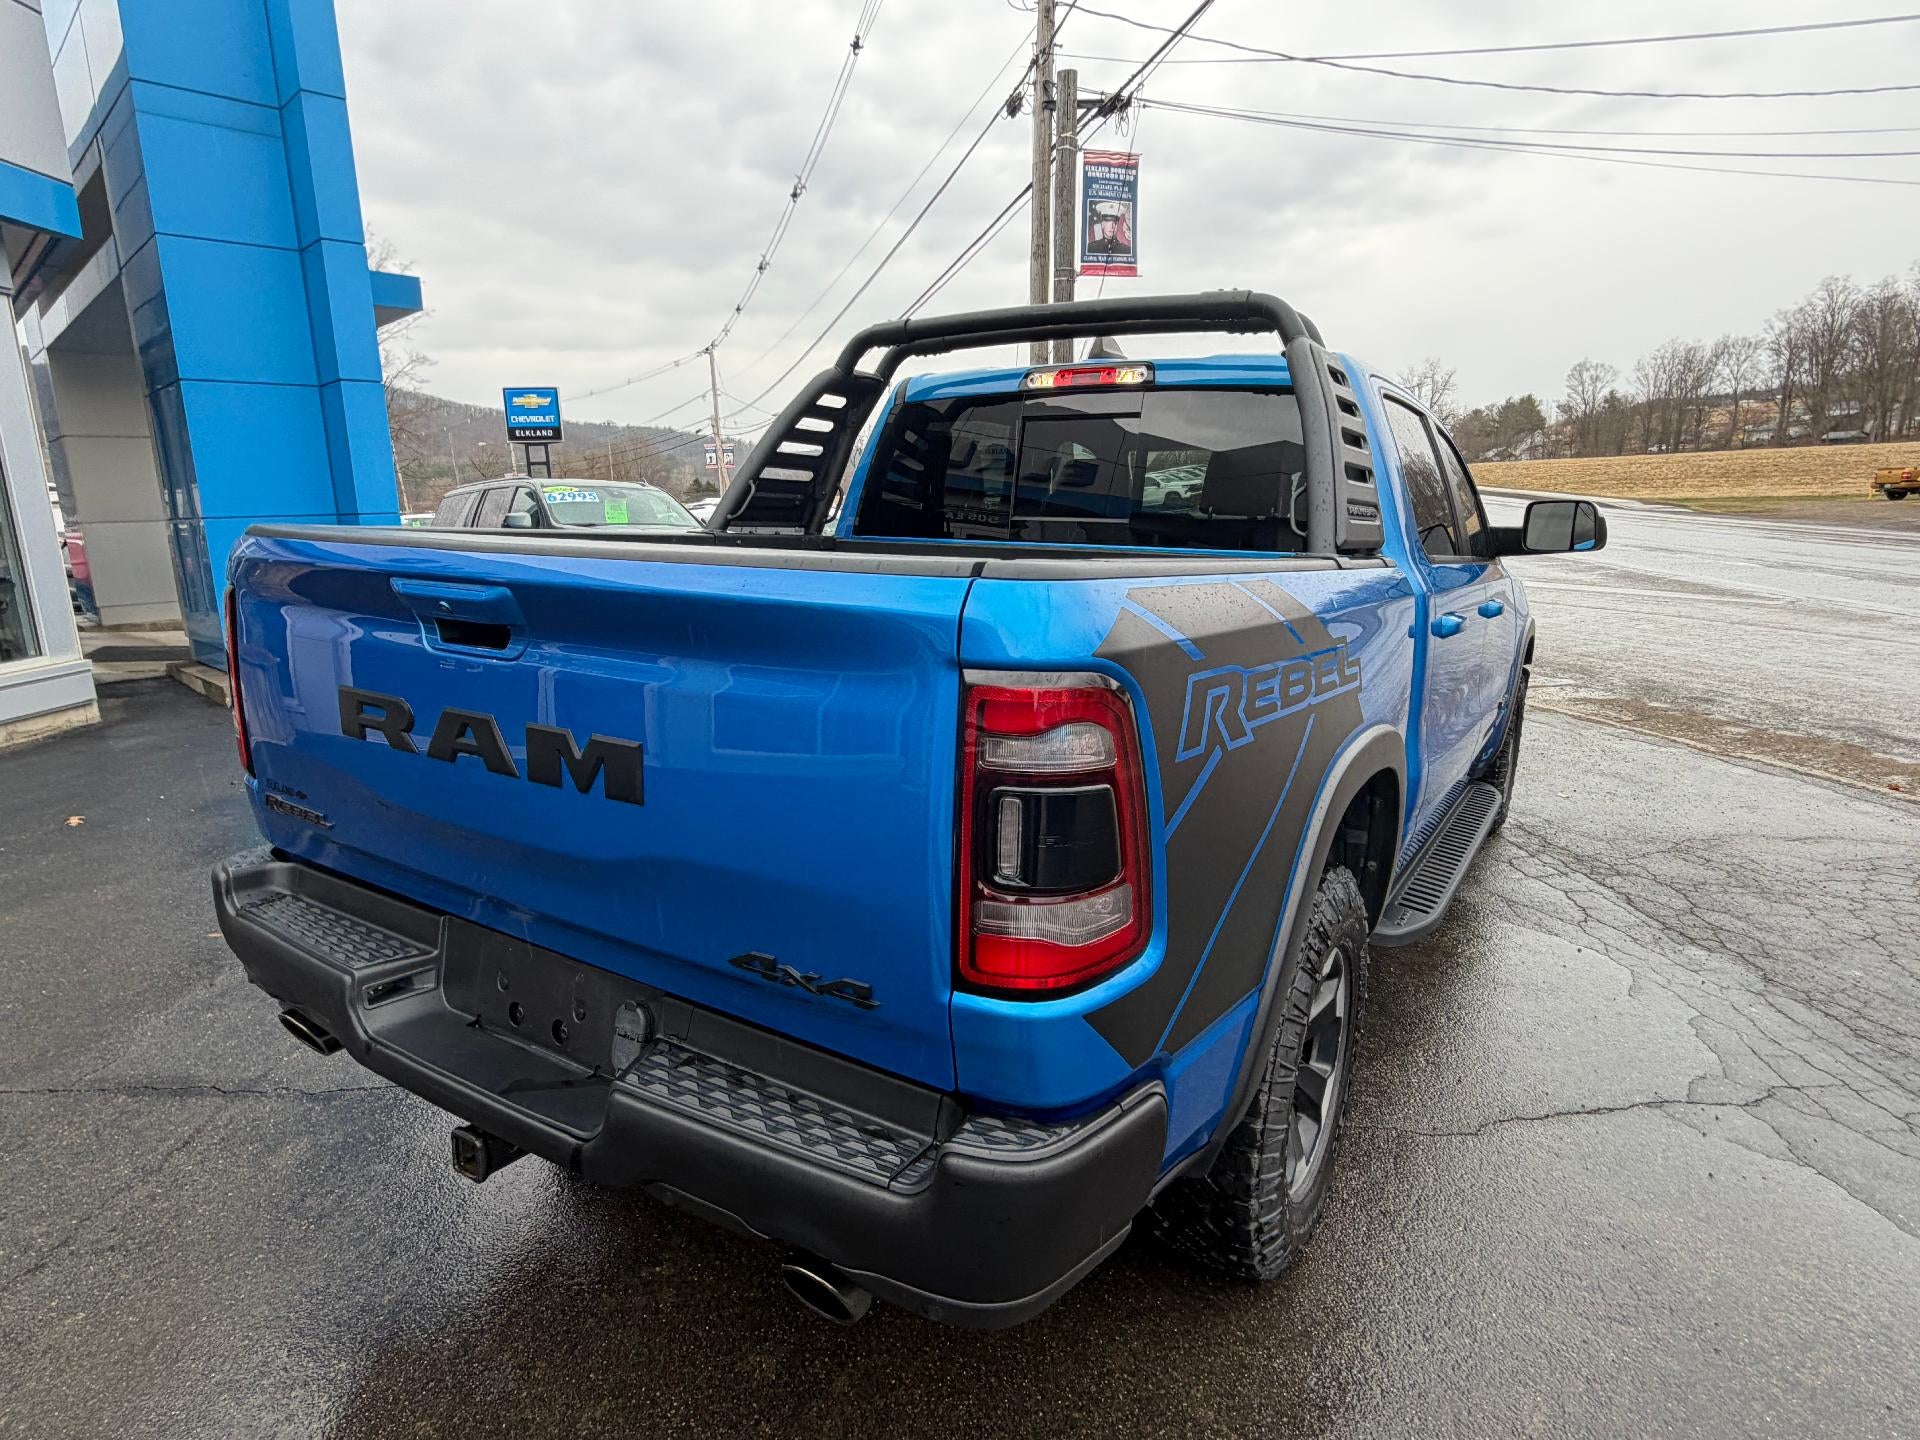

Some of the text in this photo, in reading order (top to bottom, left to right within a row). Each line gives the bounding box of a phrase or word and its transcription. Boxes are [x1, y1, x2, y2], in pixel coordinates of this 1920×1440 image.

[511, 415, 555, 423] CHEVROLET
[515, 429, 553, 437] ELKLAND
[547, 492, 597, 502] 62995
[1176, 635, 1363, 763] REBEL
[338, 684, 645, 806] RAM
